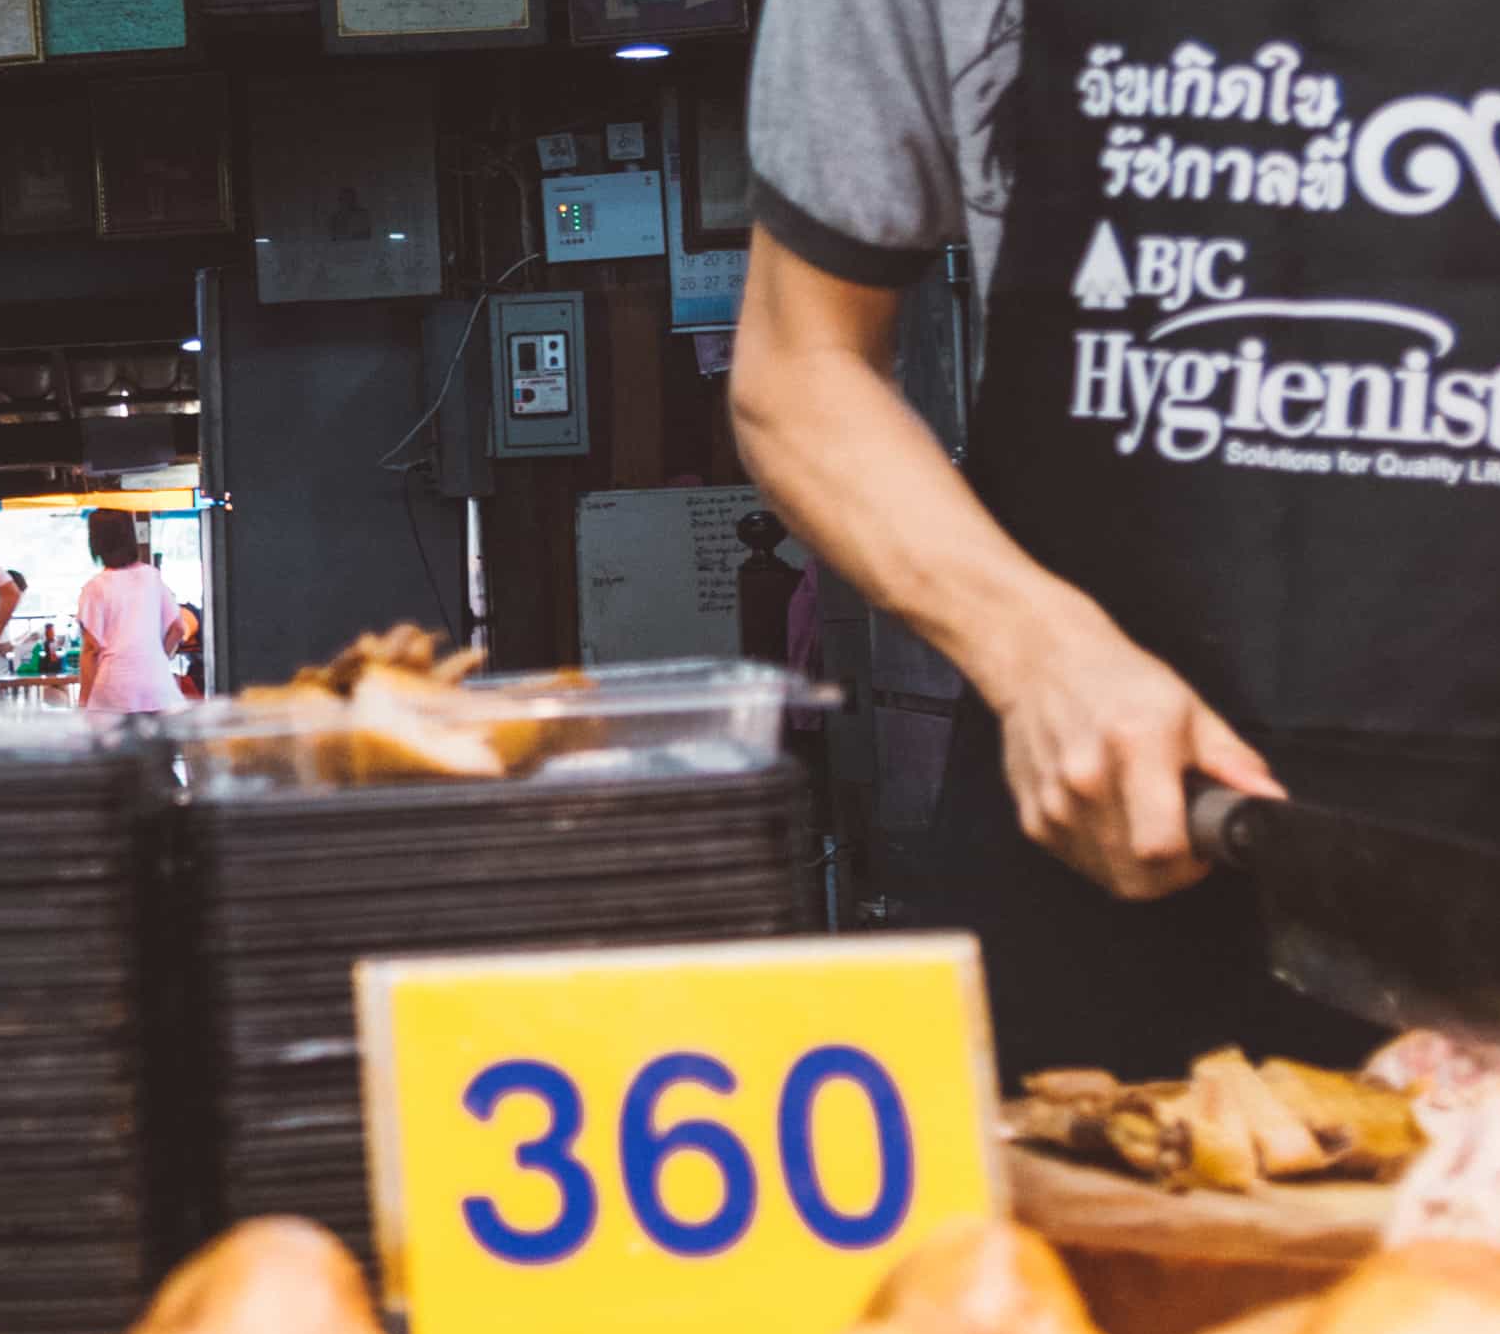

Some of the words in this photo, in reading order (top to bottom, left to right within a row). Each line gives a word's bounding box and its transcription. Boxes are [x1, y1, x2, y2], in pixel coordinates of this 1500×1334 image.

[1135, 234, 1247, 312] BJC
[1223, 438, 1333, 474] Solutions
[1337, 449, 1372, 475] for
[1375, 451, 1465, 486] Quality
[460, 1043, 915, 1267] 360
